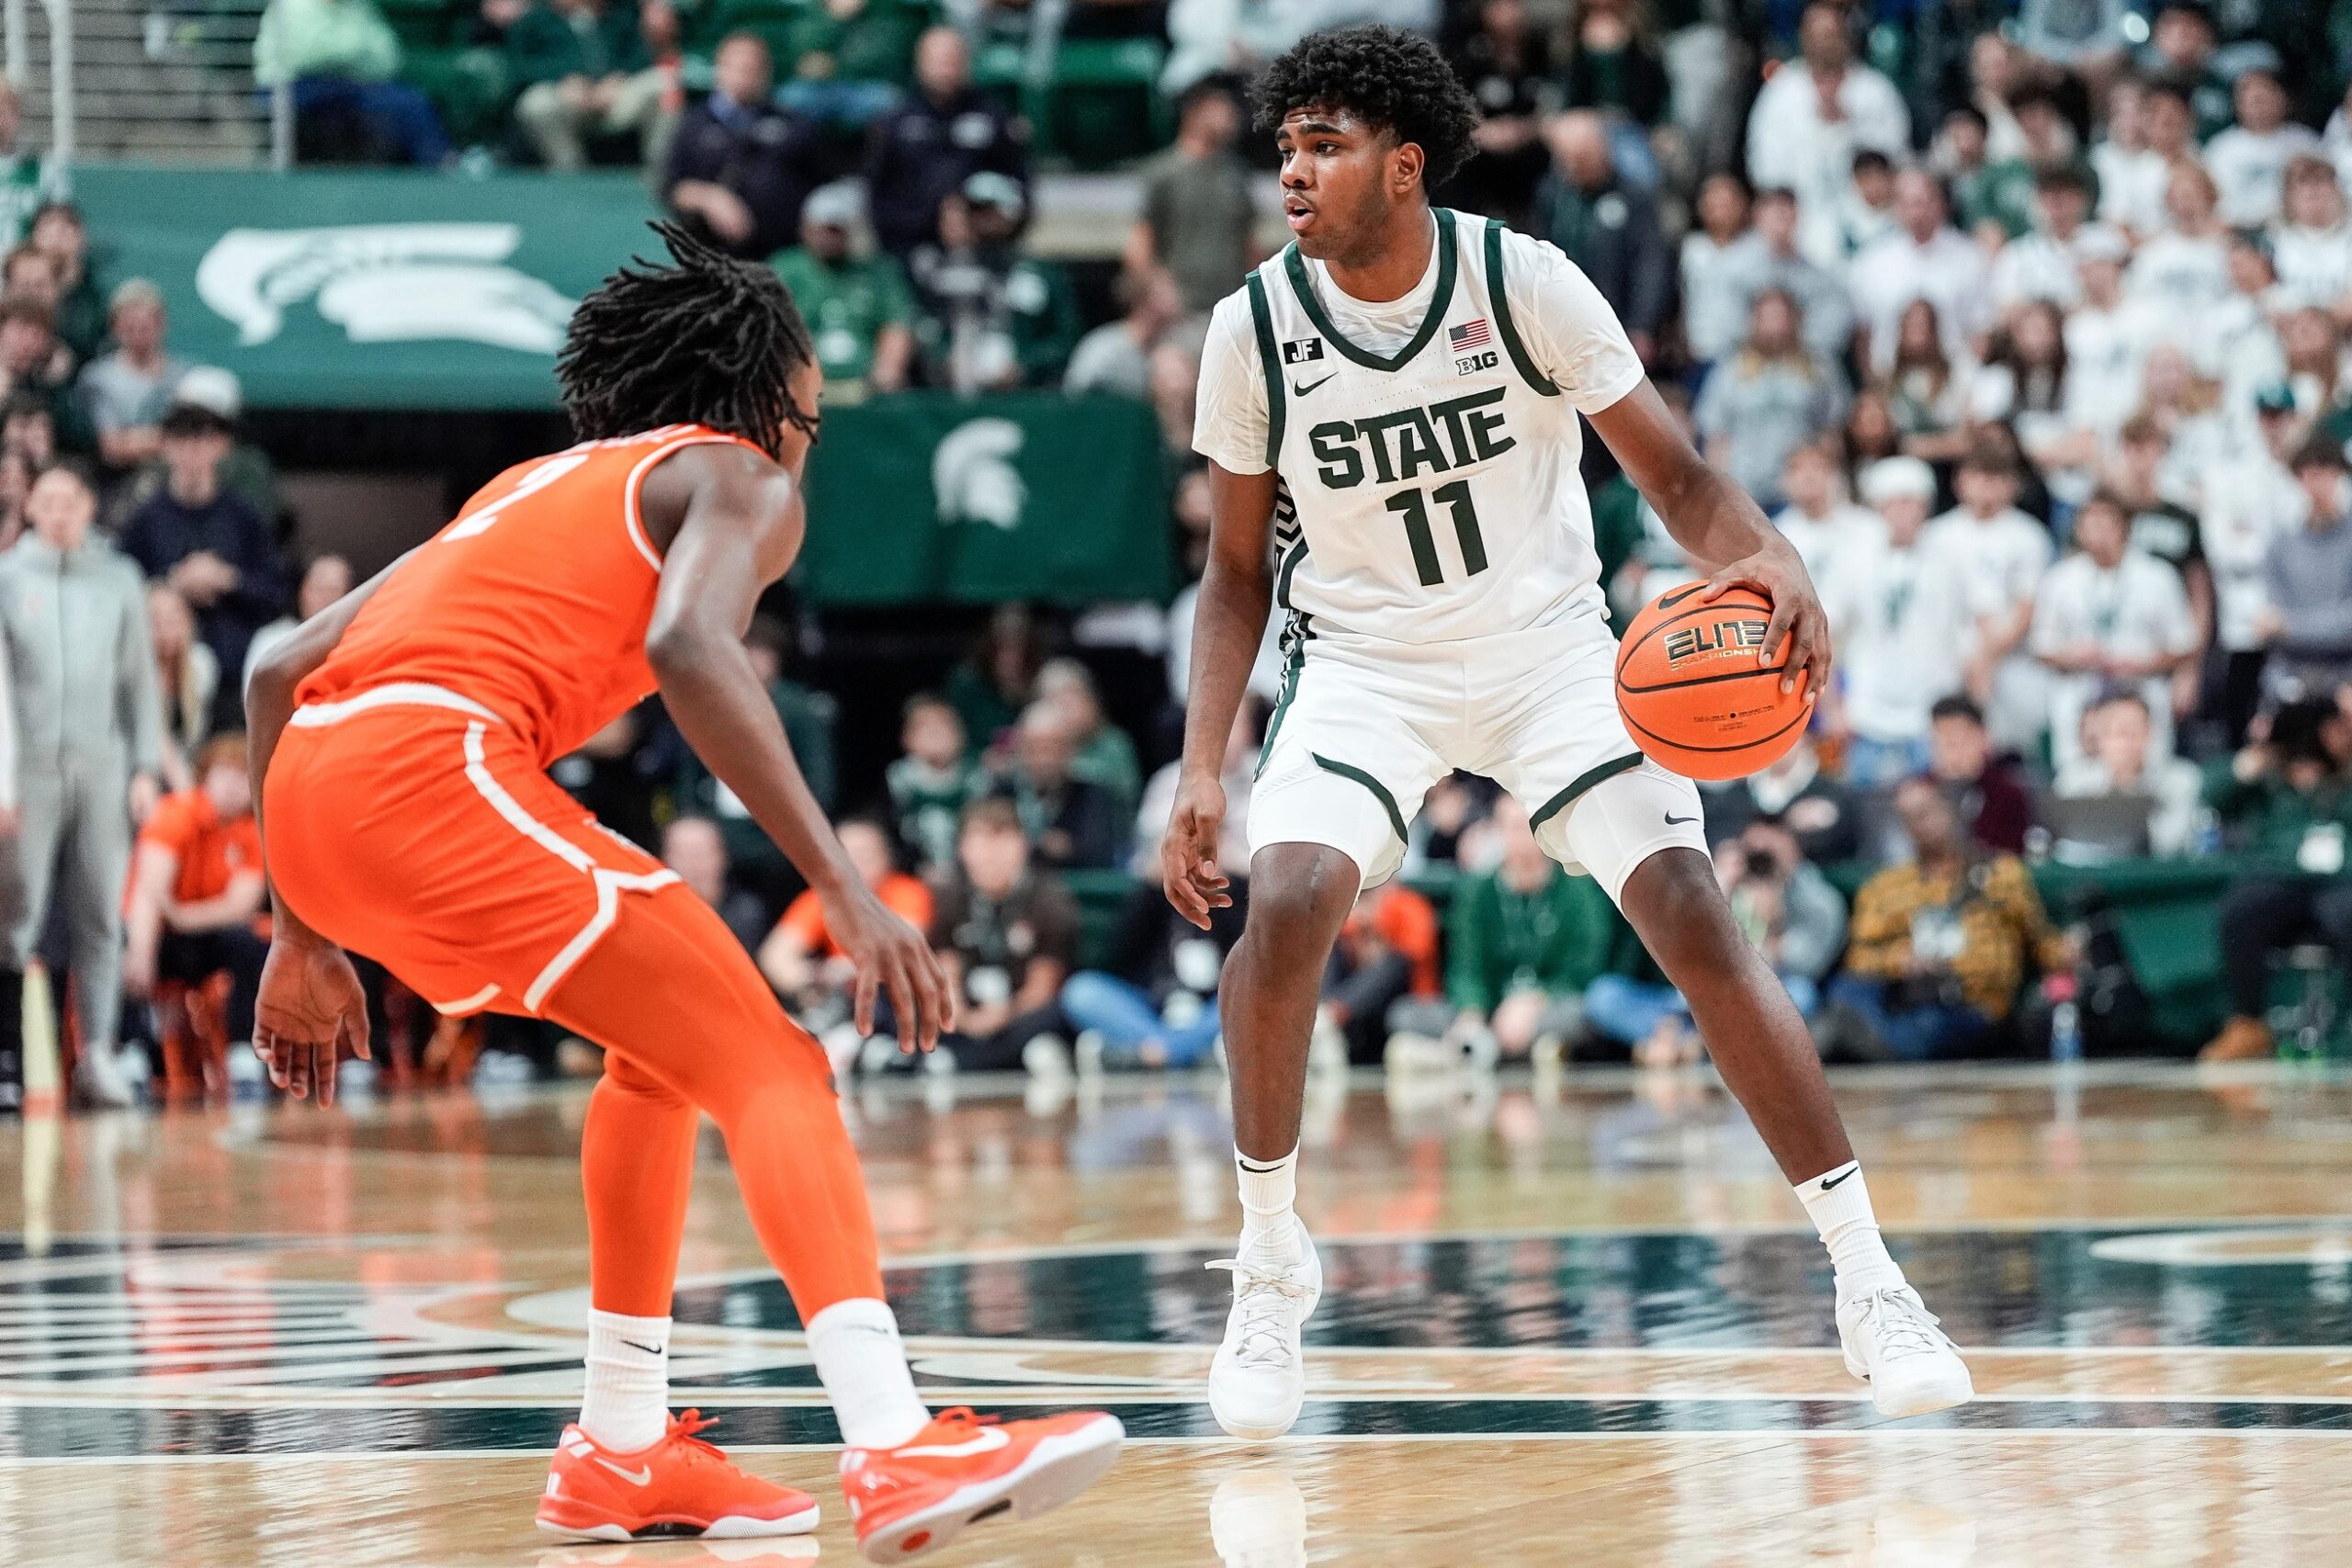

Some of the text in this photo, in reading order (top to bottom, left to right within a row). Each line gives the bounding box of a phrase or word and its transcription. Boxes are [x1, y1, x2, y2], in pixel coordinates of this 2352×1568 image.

[1291, 339, 1314, 362] JF
[1308, 386, 1517, 490] STATE
[1385, 479, 1489, 587] 11
[1664, 620, 1769, 662] ELITE
